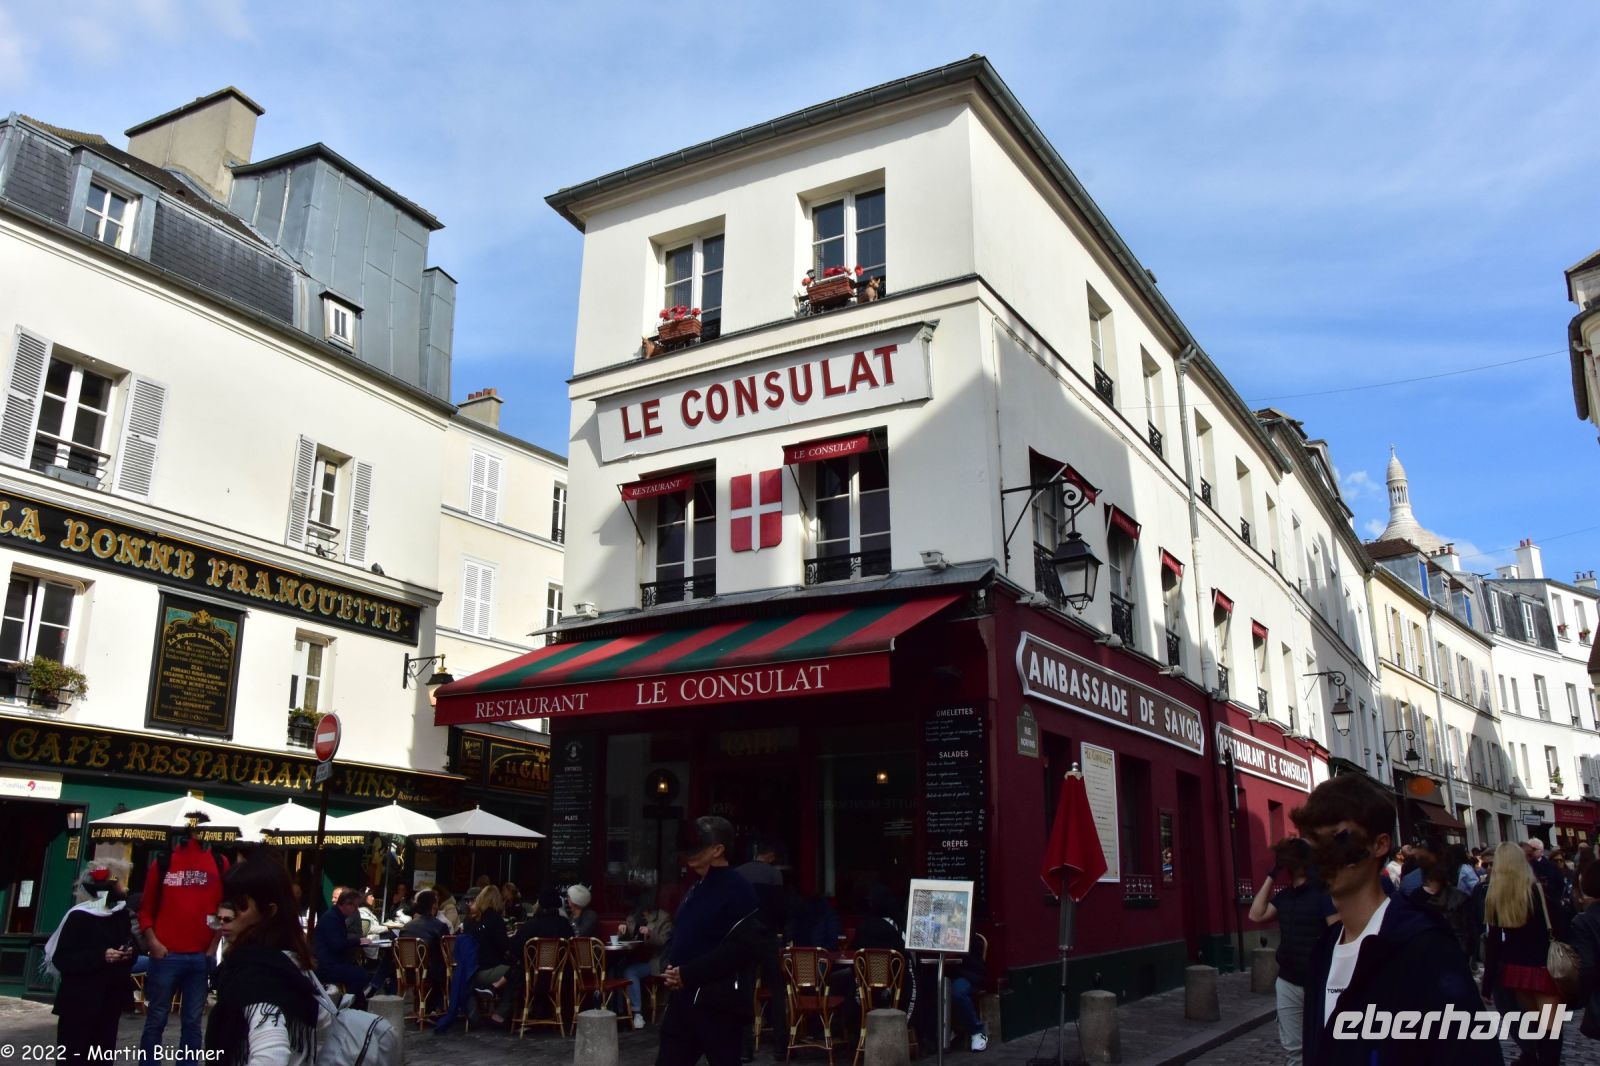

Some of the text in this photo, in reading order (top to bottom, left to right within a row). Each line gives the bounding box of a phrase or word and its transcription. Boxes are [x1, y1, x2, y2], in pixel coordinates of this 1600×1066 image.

[620, 344, 898, 442] LE CONSULAT
[794, 441, 858, 459] LE CONSULAT
[632, 480, 682, 496] RESTAURANT
[0, 501, 402, 632] LA BONNE FRANQUETTE
[636, 664, 830, 705] LE CONSULAT
[1029, 651, 1201, 745] AMBASSADE DE SAVOIE
[475, 692, 588, 719] RESTAURANT
[936, 708, 974, 717] OMELETTES
[938, 750, 969, 759] SALADES
[1268, 753, 1277, 774] LE
[1280, 758, 1308, 785] CONSULAT
[124, 741, 324, 792] RESTAURAN
[345, 769, 396, 799] VINS
[91, 829, 166, 841] LA BONNE FRANQUETTE
